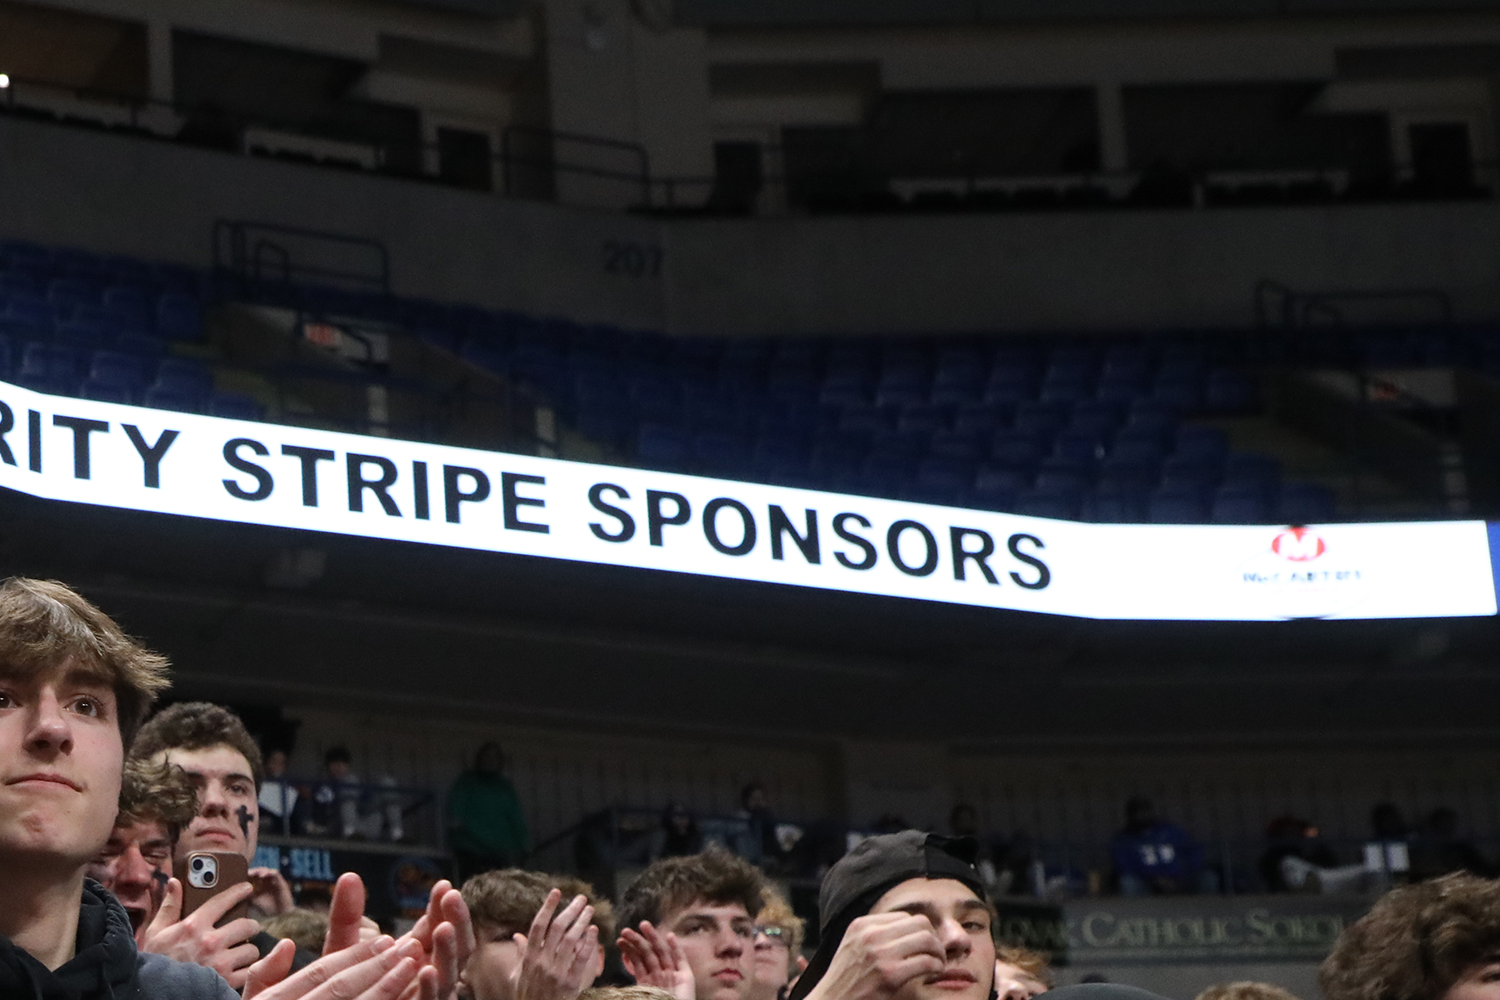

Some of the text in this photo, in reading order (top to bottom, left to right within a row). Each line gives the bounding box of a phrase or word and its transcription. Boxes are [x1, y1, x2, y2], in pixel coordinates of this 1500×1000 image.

[603, 242, 663, 279] 207
[221, 437, 550, 534] STRIPE
[587, 482, 1052, 590] SPONSORS
